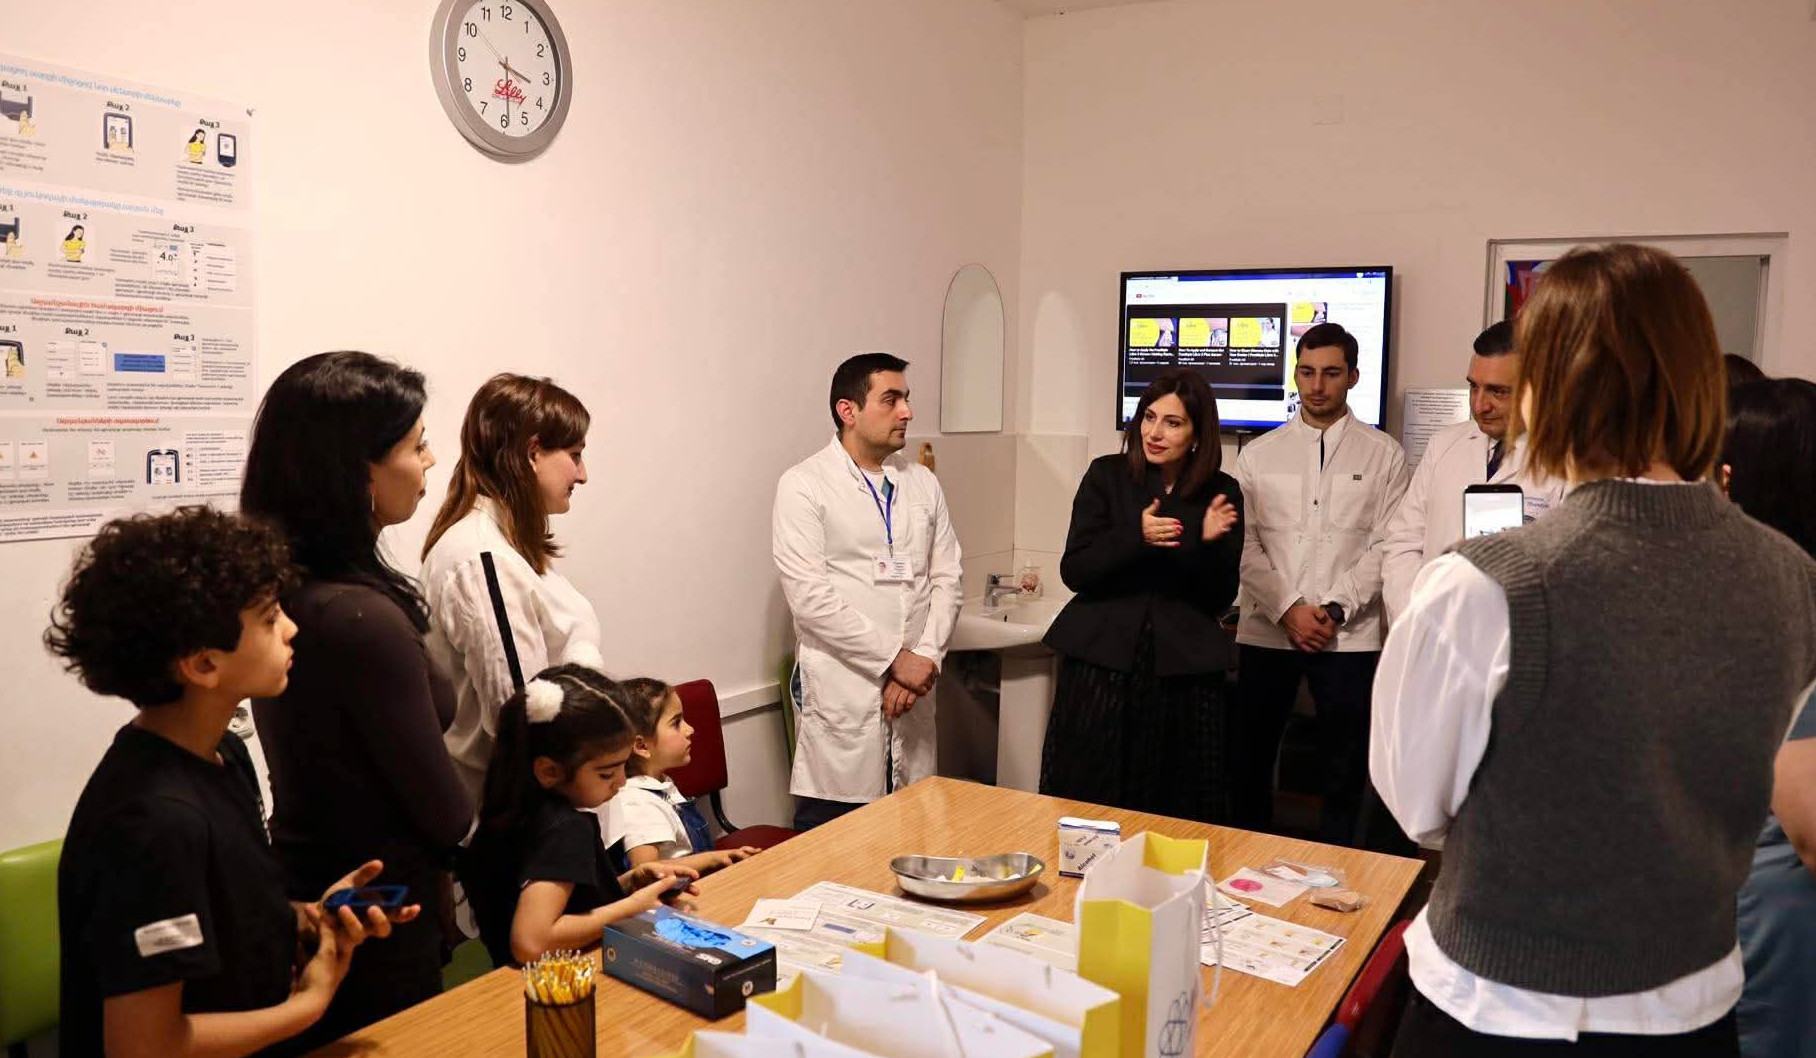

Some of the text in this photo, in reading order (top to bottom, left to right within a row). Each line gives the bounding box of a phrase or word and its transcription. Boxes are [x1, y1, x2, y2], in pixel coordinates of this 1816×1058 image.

[481, 6, 491, 22] 11
[500, 5, 513, 21] 12
[464, 22, 477, 38] 10
[524, 21, 529, 34] 1
[458, 47, 466, 62] 9
[536, 43, 545, 58] 2
[464, 77, 472, 92] 8
[542, 72, 550, 86] 3
[494, 79, 527, 106] Lilly
[480, 101, 488, 115] 7
[535, 96, 543, 110] 4
[500, 114, 508, 128] 6
[521, 112, 528, 126] 5
